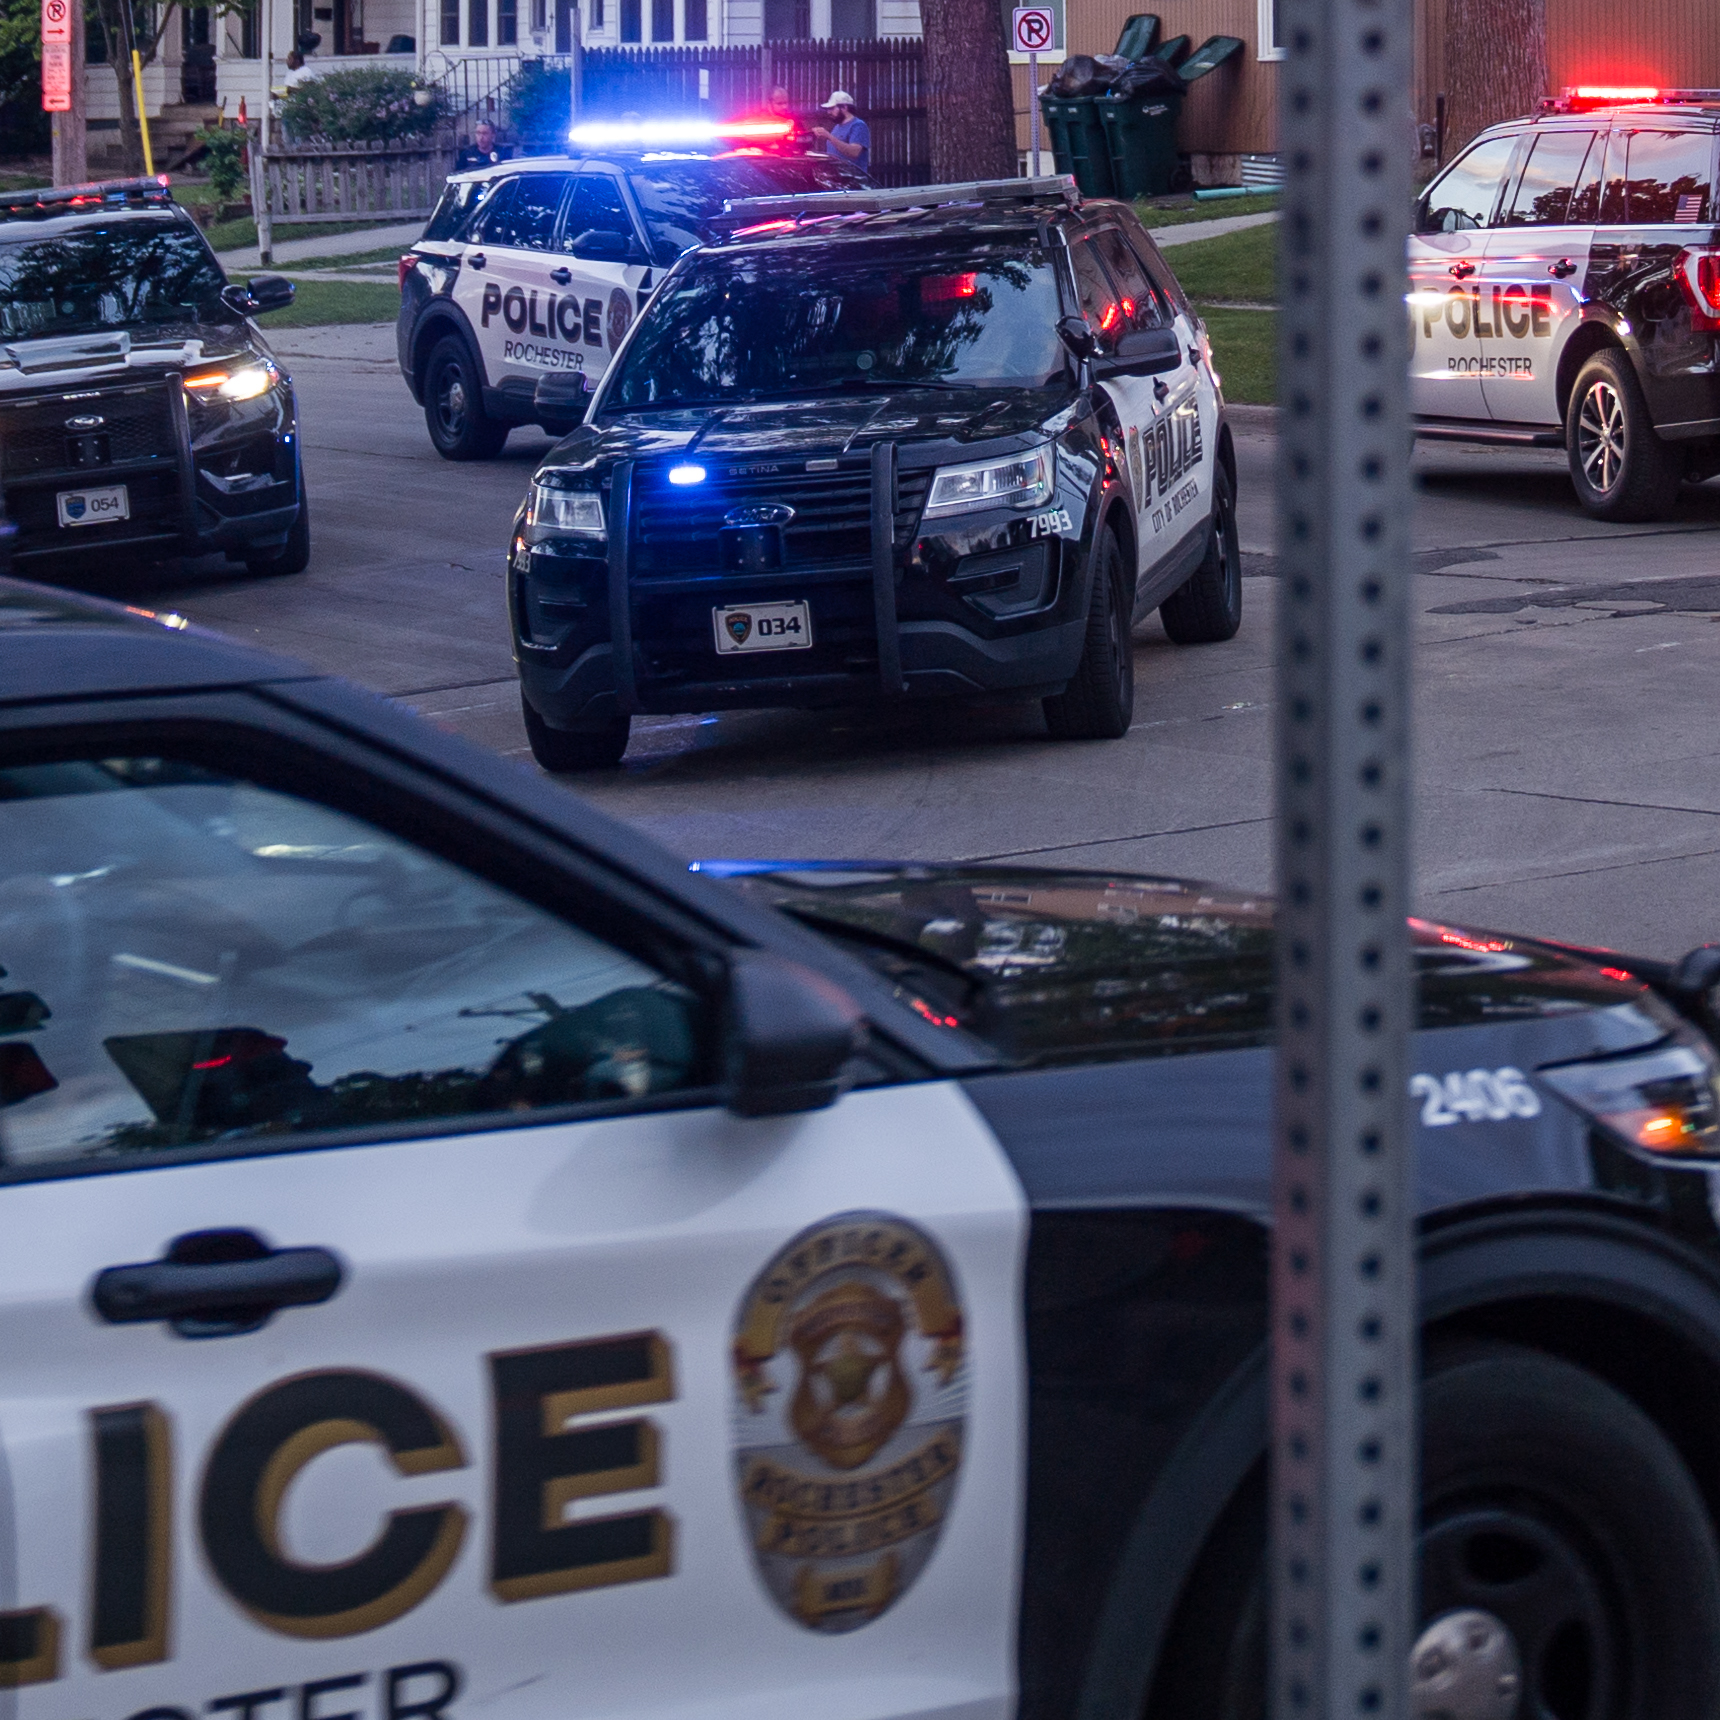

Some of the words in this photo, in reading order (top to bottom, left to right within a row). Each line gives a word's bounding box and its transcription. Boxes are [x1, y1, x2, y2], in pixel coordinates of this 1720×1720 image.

[481, 282, 603, 348] POLICE
[1422, 284, 1552, 340] POLICE
[504, 340, 584, 369] ROCHESTER
[1448, 357, 1533, 378] ROCHESTER
[1142, 392, 1203, 510] POLICE
[729, 465, 780, 476] SETINA
[90, 496, 119, 512] 054
[1026, 510, 1073, 538] 7993
[757, 616, 801, 636] 034
